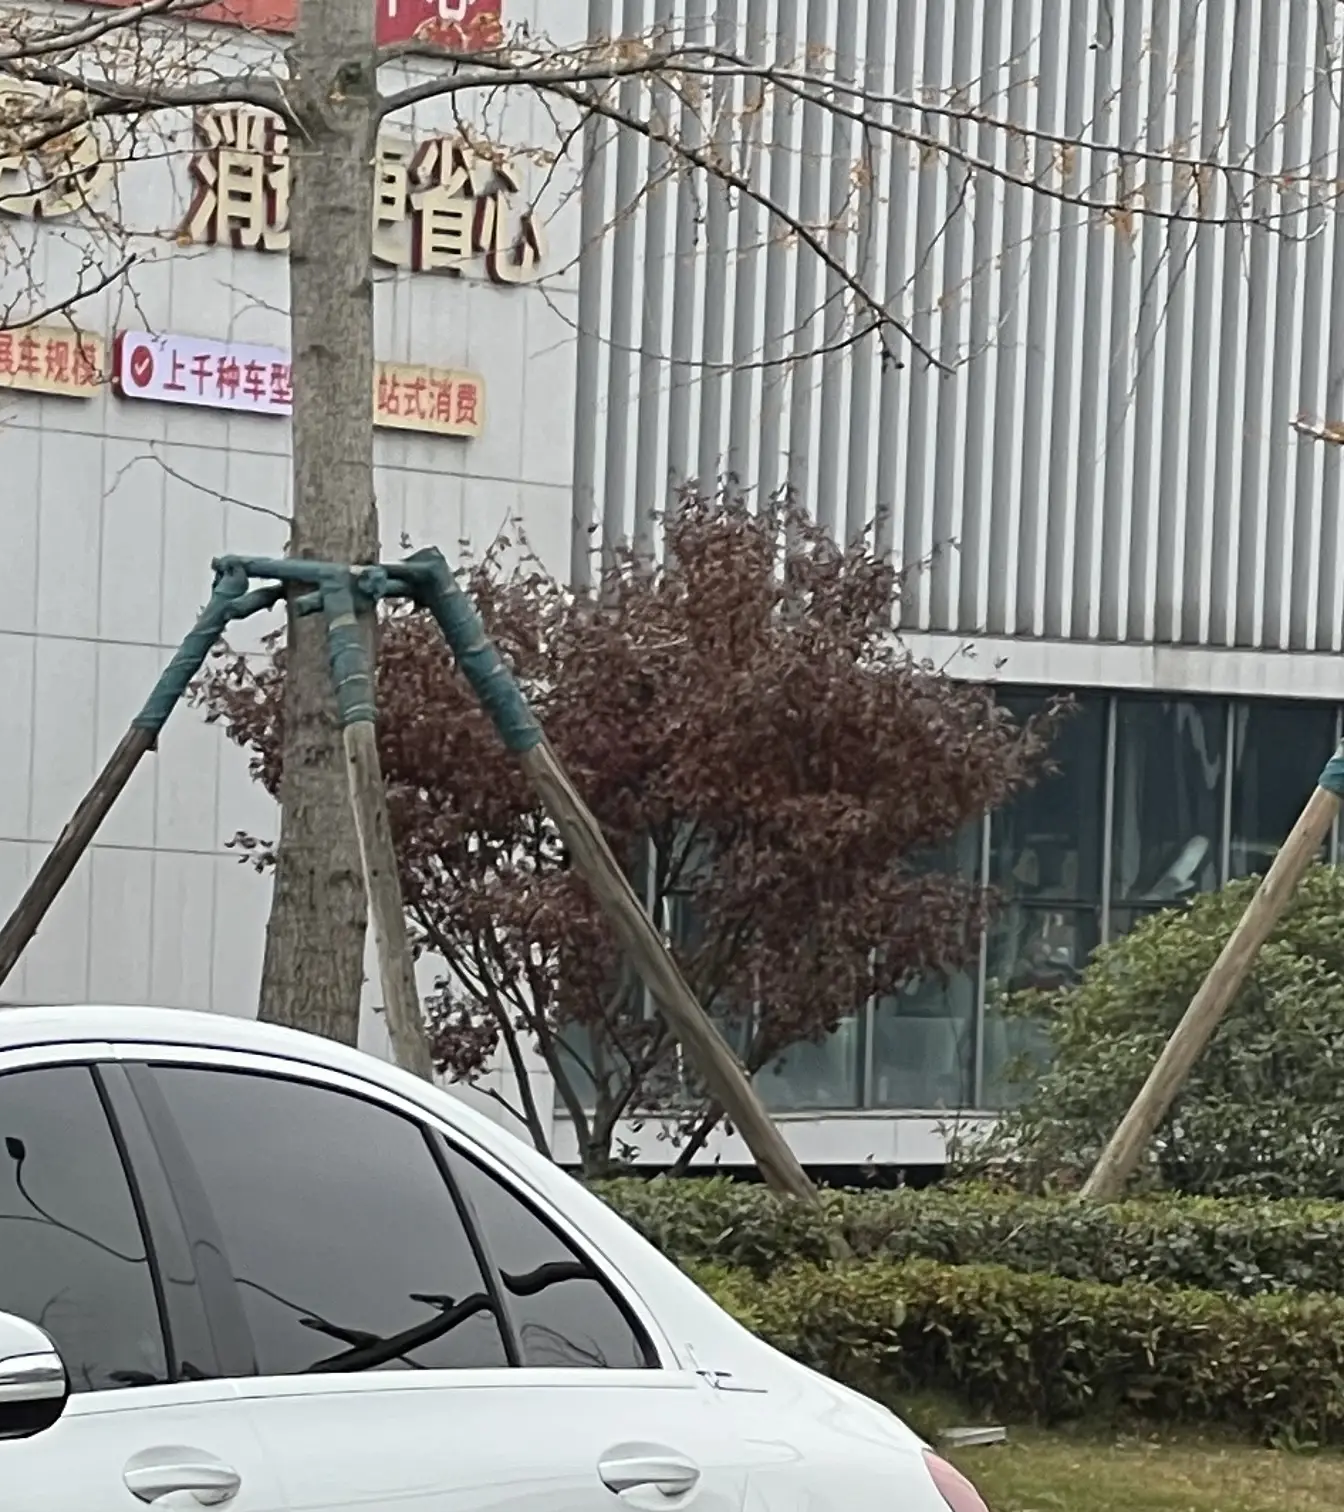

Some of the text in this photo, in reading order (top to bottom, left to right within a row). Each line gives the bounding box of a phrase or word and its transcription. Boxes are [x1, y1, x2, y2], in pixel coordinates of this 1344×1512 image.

[163, 348, 293, 405] 上千种车型
